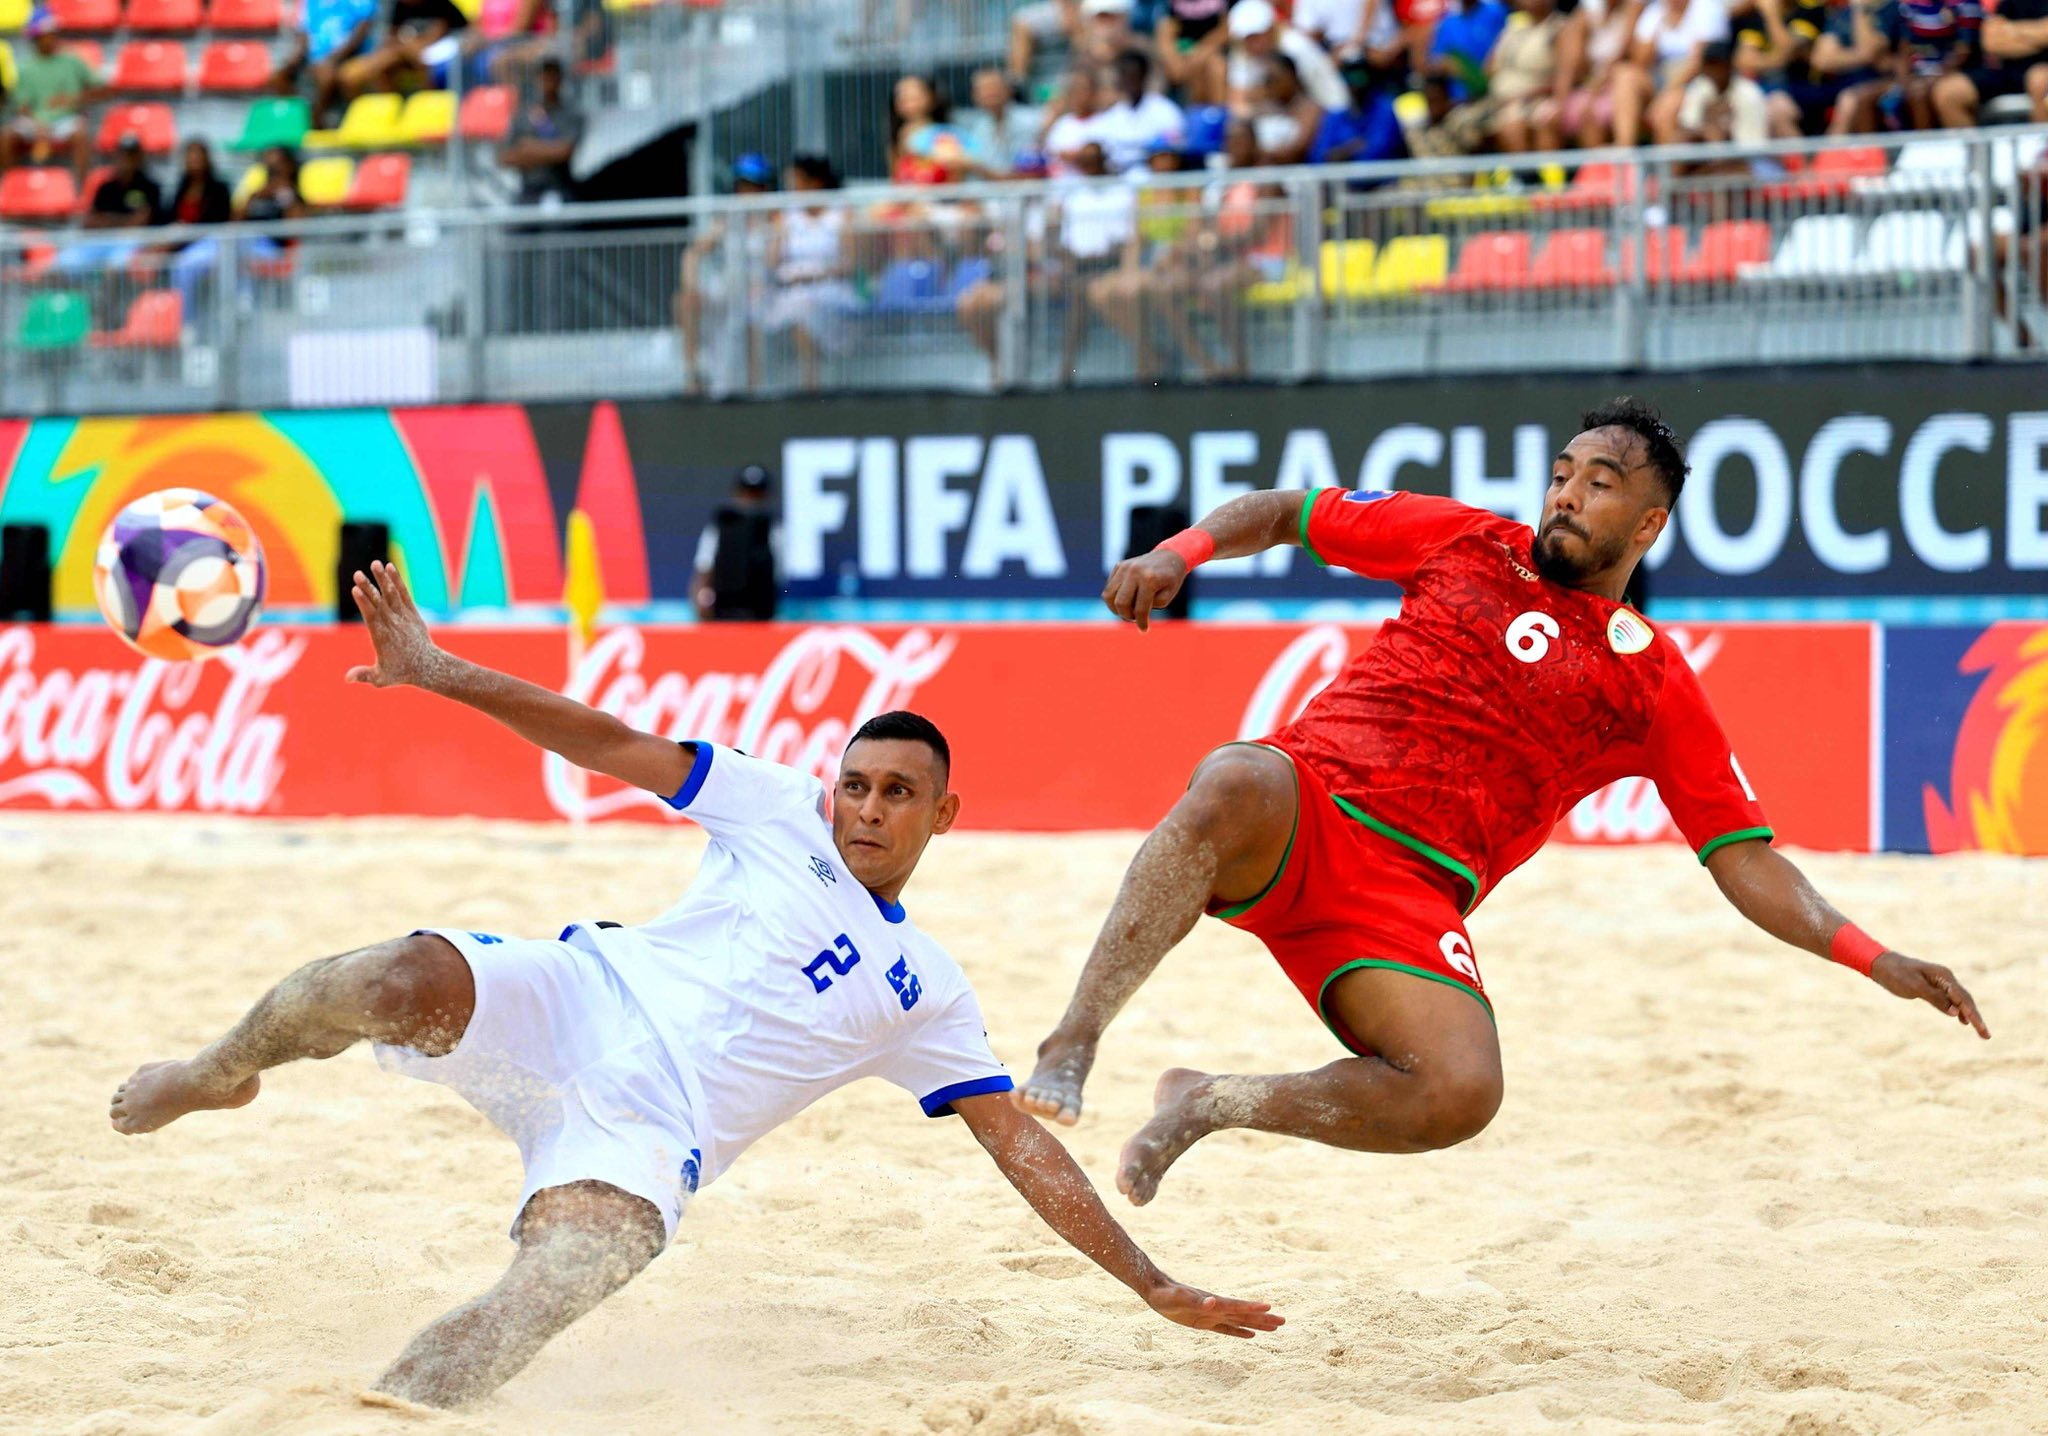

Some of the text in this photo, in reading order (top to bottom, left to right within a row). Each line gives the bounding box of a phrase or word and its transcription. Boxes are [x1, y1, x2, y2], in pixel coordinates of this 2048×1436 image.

[782, 433, 1068, 579] FIFA
[1642, 411, 2048, 577] OCCE
[1505, 611, 1560, 663] 6
[801, 933, 861, 994] 2
